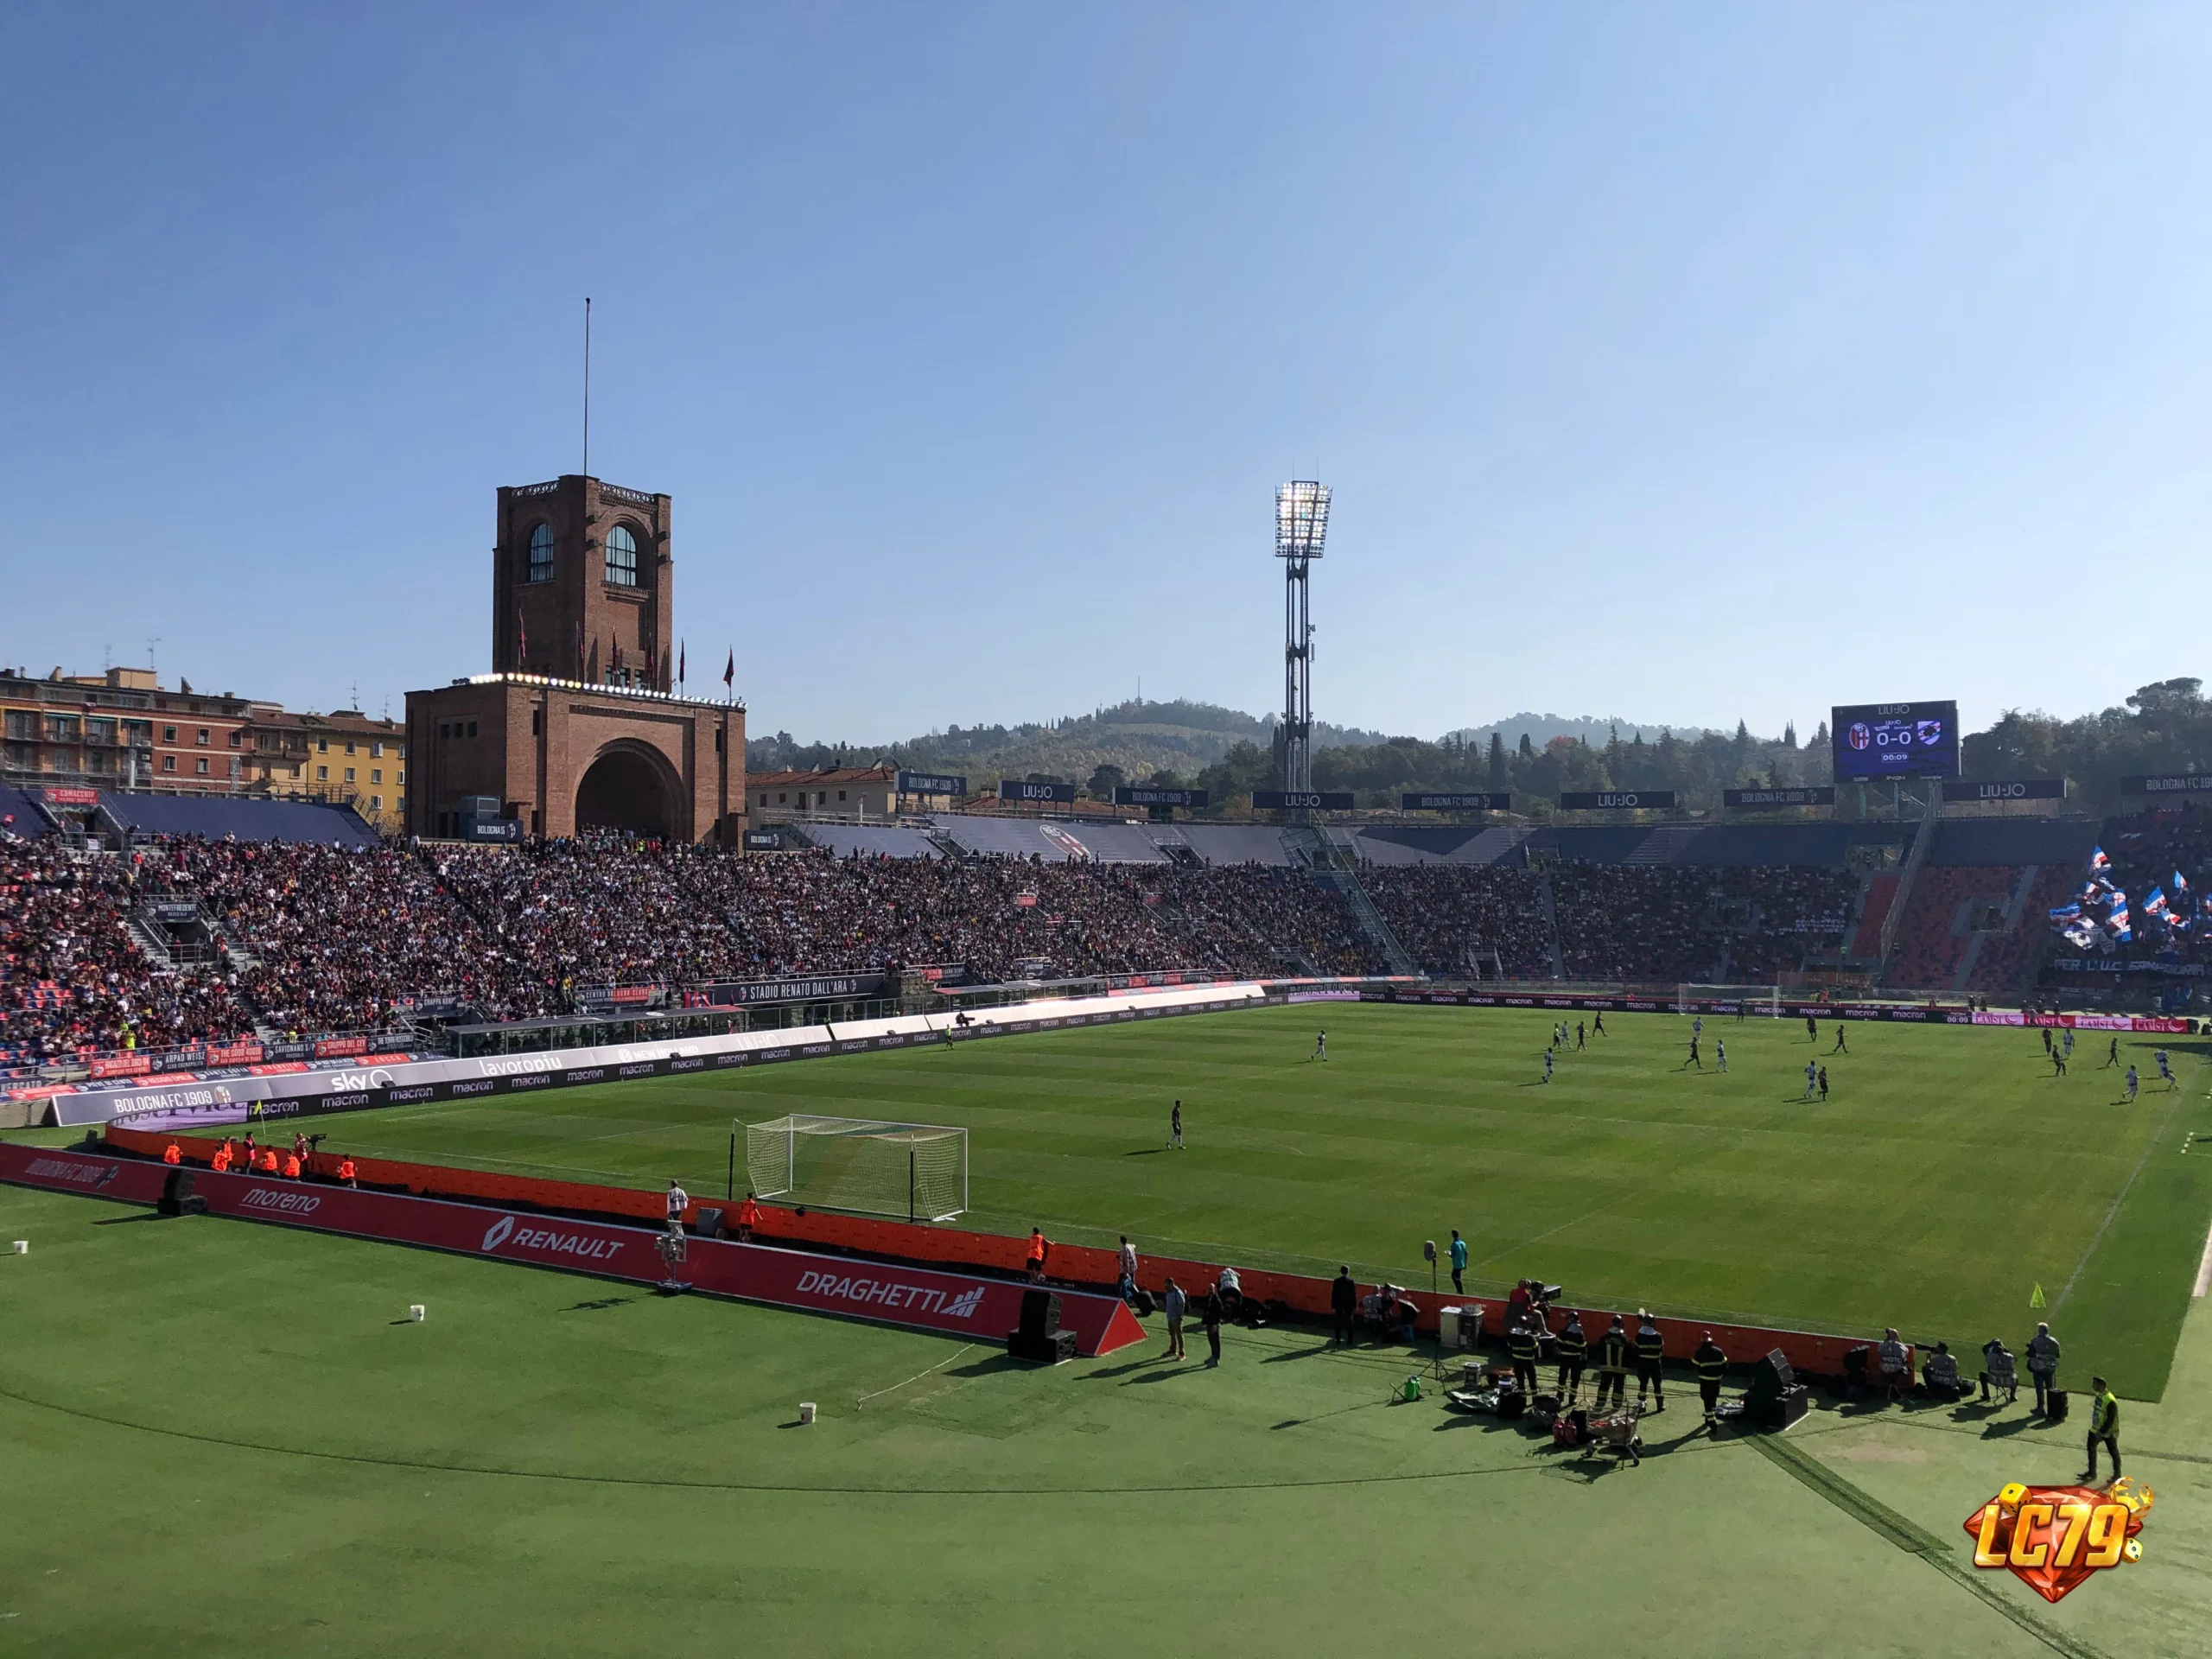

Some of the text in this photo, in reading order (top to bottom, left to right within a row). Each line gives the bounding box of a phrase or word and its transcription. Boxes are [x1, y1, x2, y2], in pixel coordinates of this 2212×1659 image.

[908, 777, 951, 791] BOLOGNA FC 1909
[2145, 777, 2212, 791] BOLOGNA FC 19
[1132, 791, 1182, 804] BOLOGNA FC 1909
[1421, 797, 1479, 808] BOLOGNA FC 1909
[1741, 791, 1805, 803] BOLOGNA FC 1909
[477, 825, 500, 836] BOLOGNA
[2054, 958, 2082, 971] PER
[750, 980, 847, 1000] STADIO RENATO DALL'ARA
[1799, 1007, 1832, 1016] macron
[1846, 1009, 1878, 1018] macron
[1010, 1022, 1032, 1032] macron
[2081, 1018, 2109, 1028] CAMST
[2135, 1020, 2165, 1031] CAMST
[980, 1026, 1002, 1034] macron
[879, 1036, 904, 1046] macron
[913, 1033, 938, 1042] macron
[275, 1043, 315, 1054] SAVIGNANO S/P
[327, 1040, 346, 1050] GRUPPO
[802, 1044, 830, 1054] macron
[842, 1040, 868, 1051] macron
[165, 1051, 206, 1064] ARPAD WEISZ
[220, 1050, 229, 1058] THE
[632, 1044, 700, 1061] NEW HOLLAND
[761, 1049, 790, 1059] macron
[671, 1058, 703, 1070] macron
[718, 1053, 748, 1065] macron
[567, 1069, 603, 1082] macron
[620, 1064, 654, 1076] macron
[331, 1071, 366, 1091] sky
[453, 1080, 493, 1094] macron
[512, 1075, 550, 1087] macron
[391, 1087, 433, 1101] macron
[114, 1090, 213, 1114] BOLOGNA FC 1909
[321, 1094, 368, 1108] macron
[249, 1101, 299, 1116] macron
[241, 1187, 321, 1212] moreno
[512, 1227, 625, 1260] RENAULT
[795, 1270, 949, 1313] DRAGHETTI
